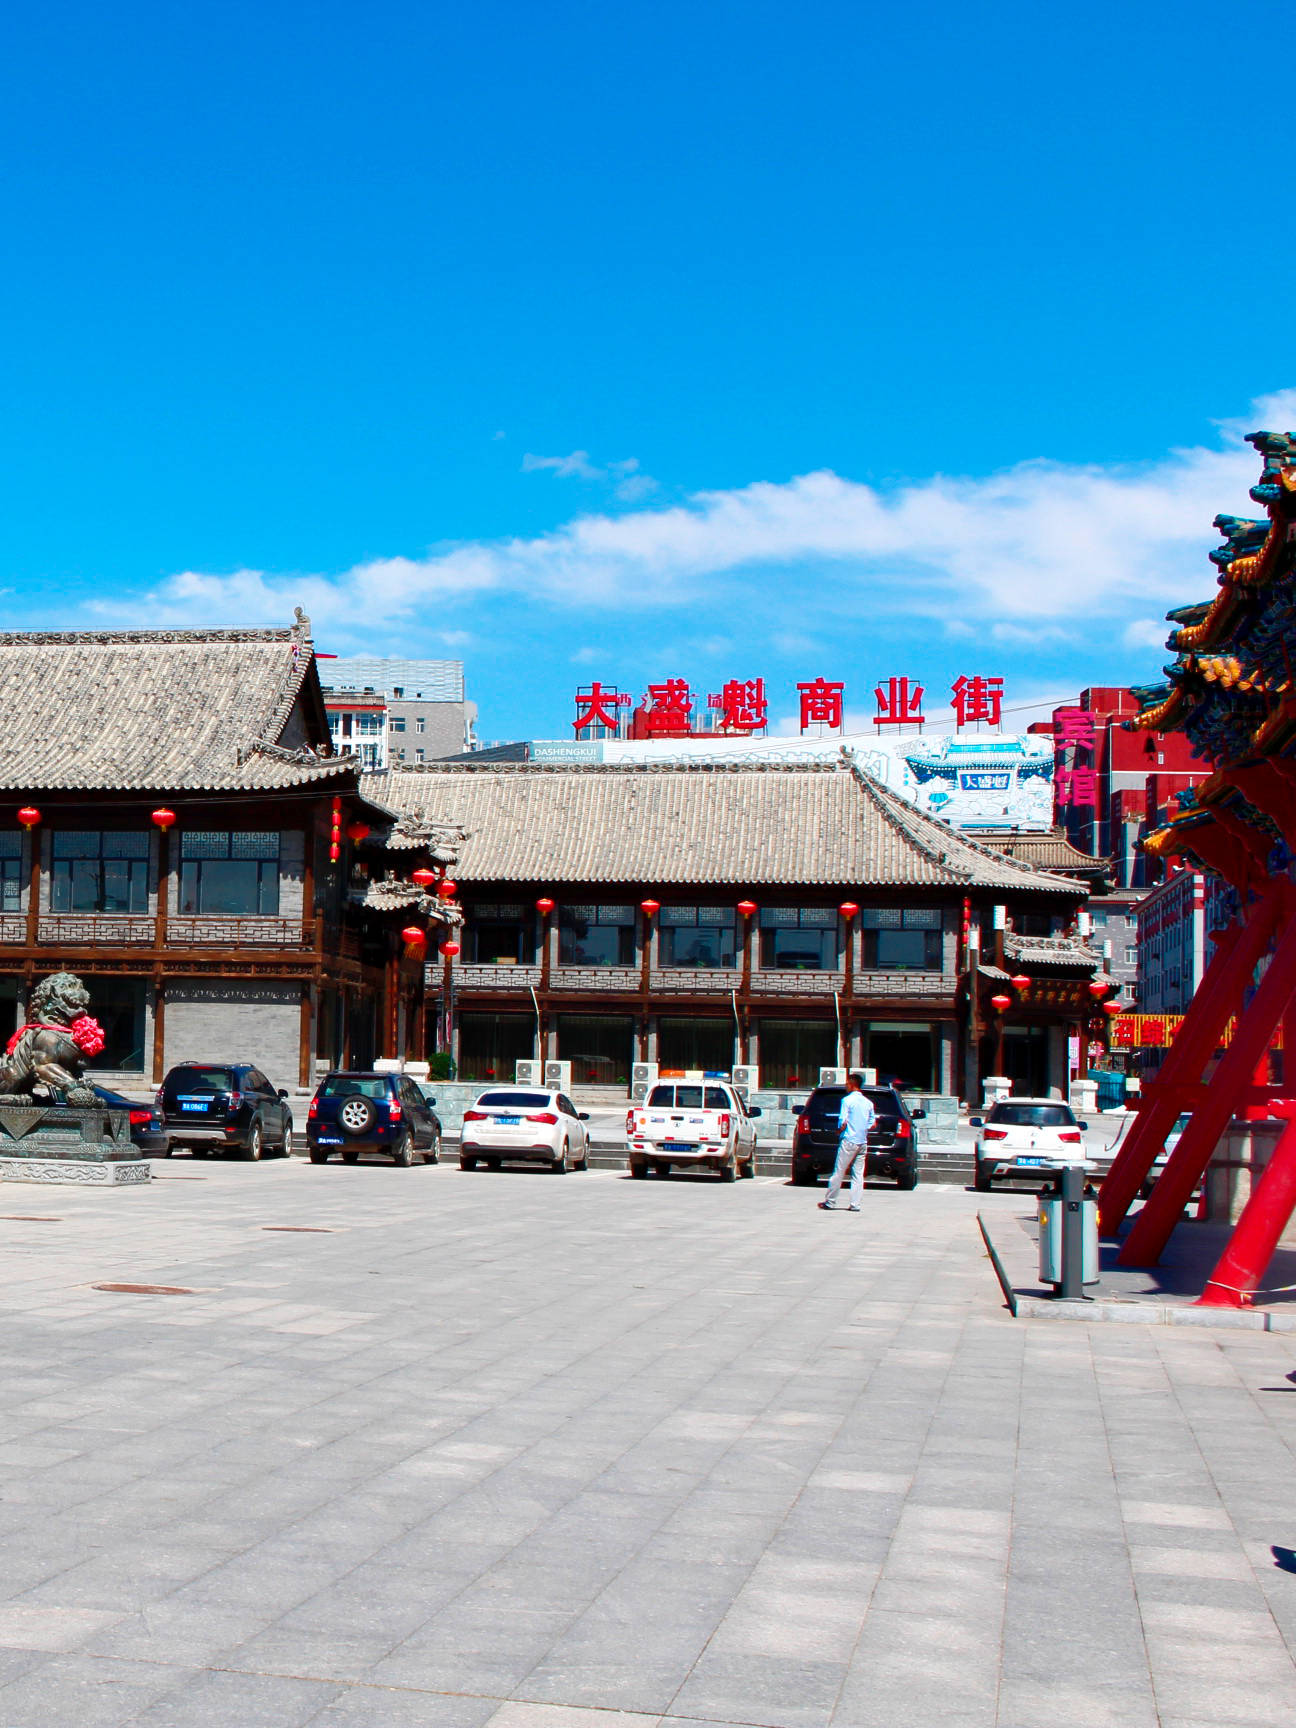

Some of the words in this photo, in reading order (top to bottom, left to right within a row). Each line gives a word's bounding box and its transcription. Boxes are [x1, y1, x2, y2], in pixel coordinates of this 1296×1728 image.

[572, 675, 1003, 730] 大盛魁商业街
[534, 748, 597, 756] DASHENGKUI
[1054, 708, 1097, 806] 宾馆
